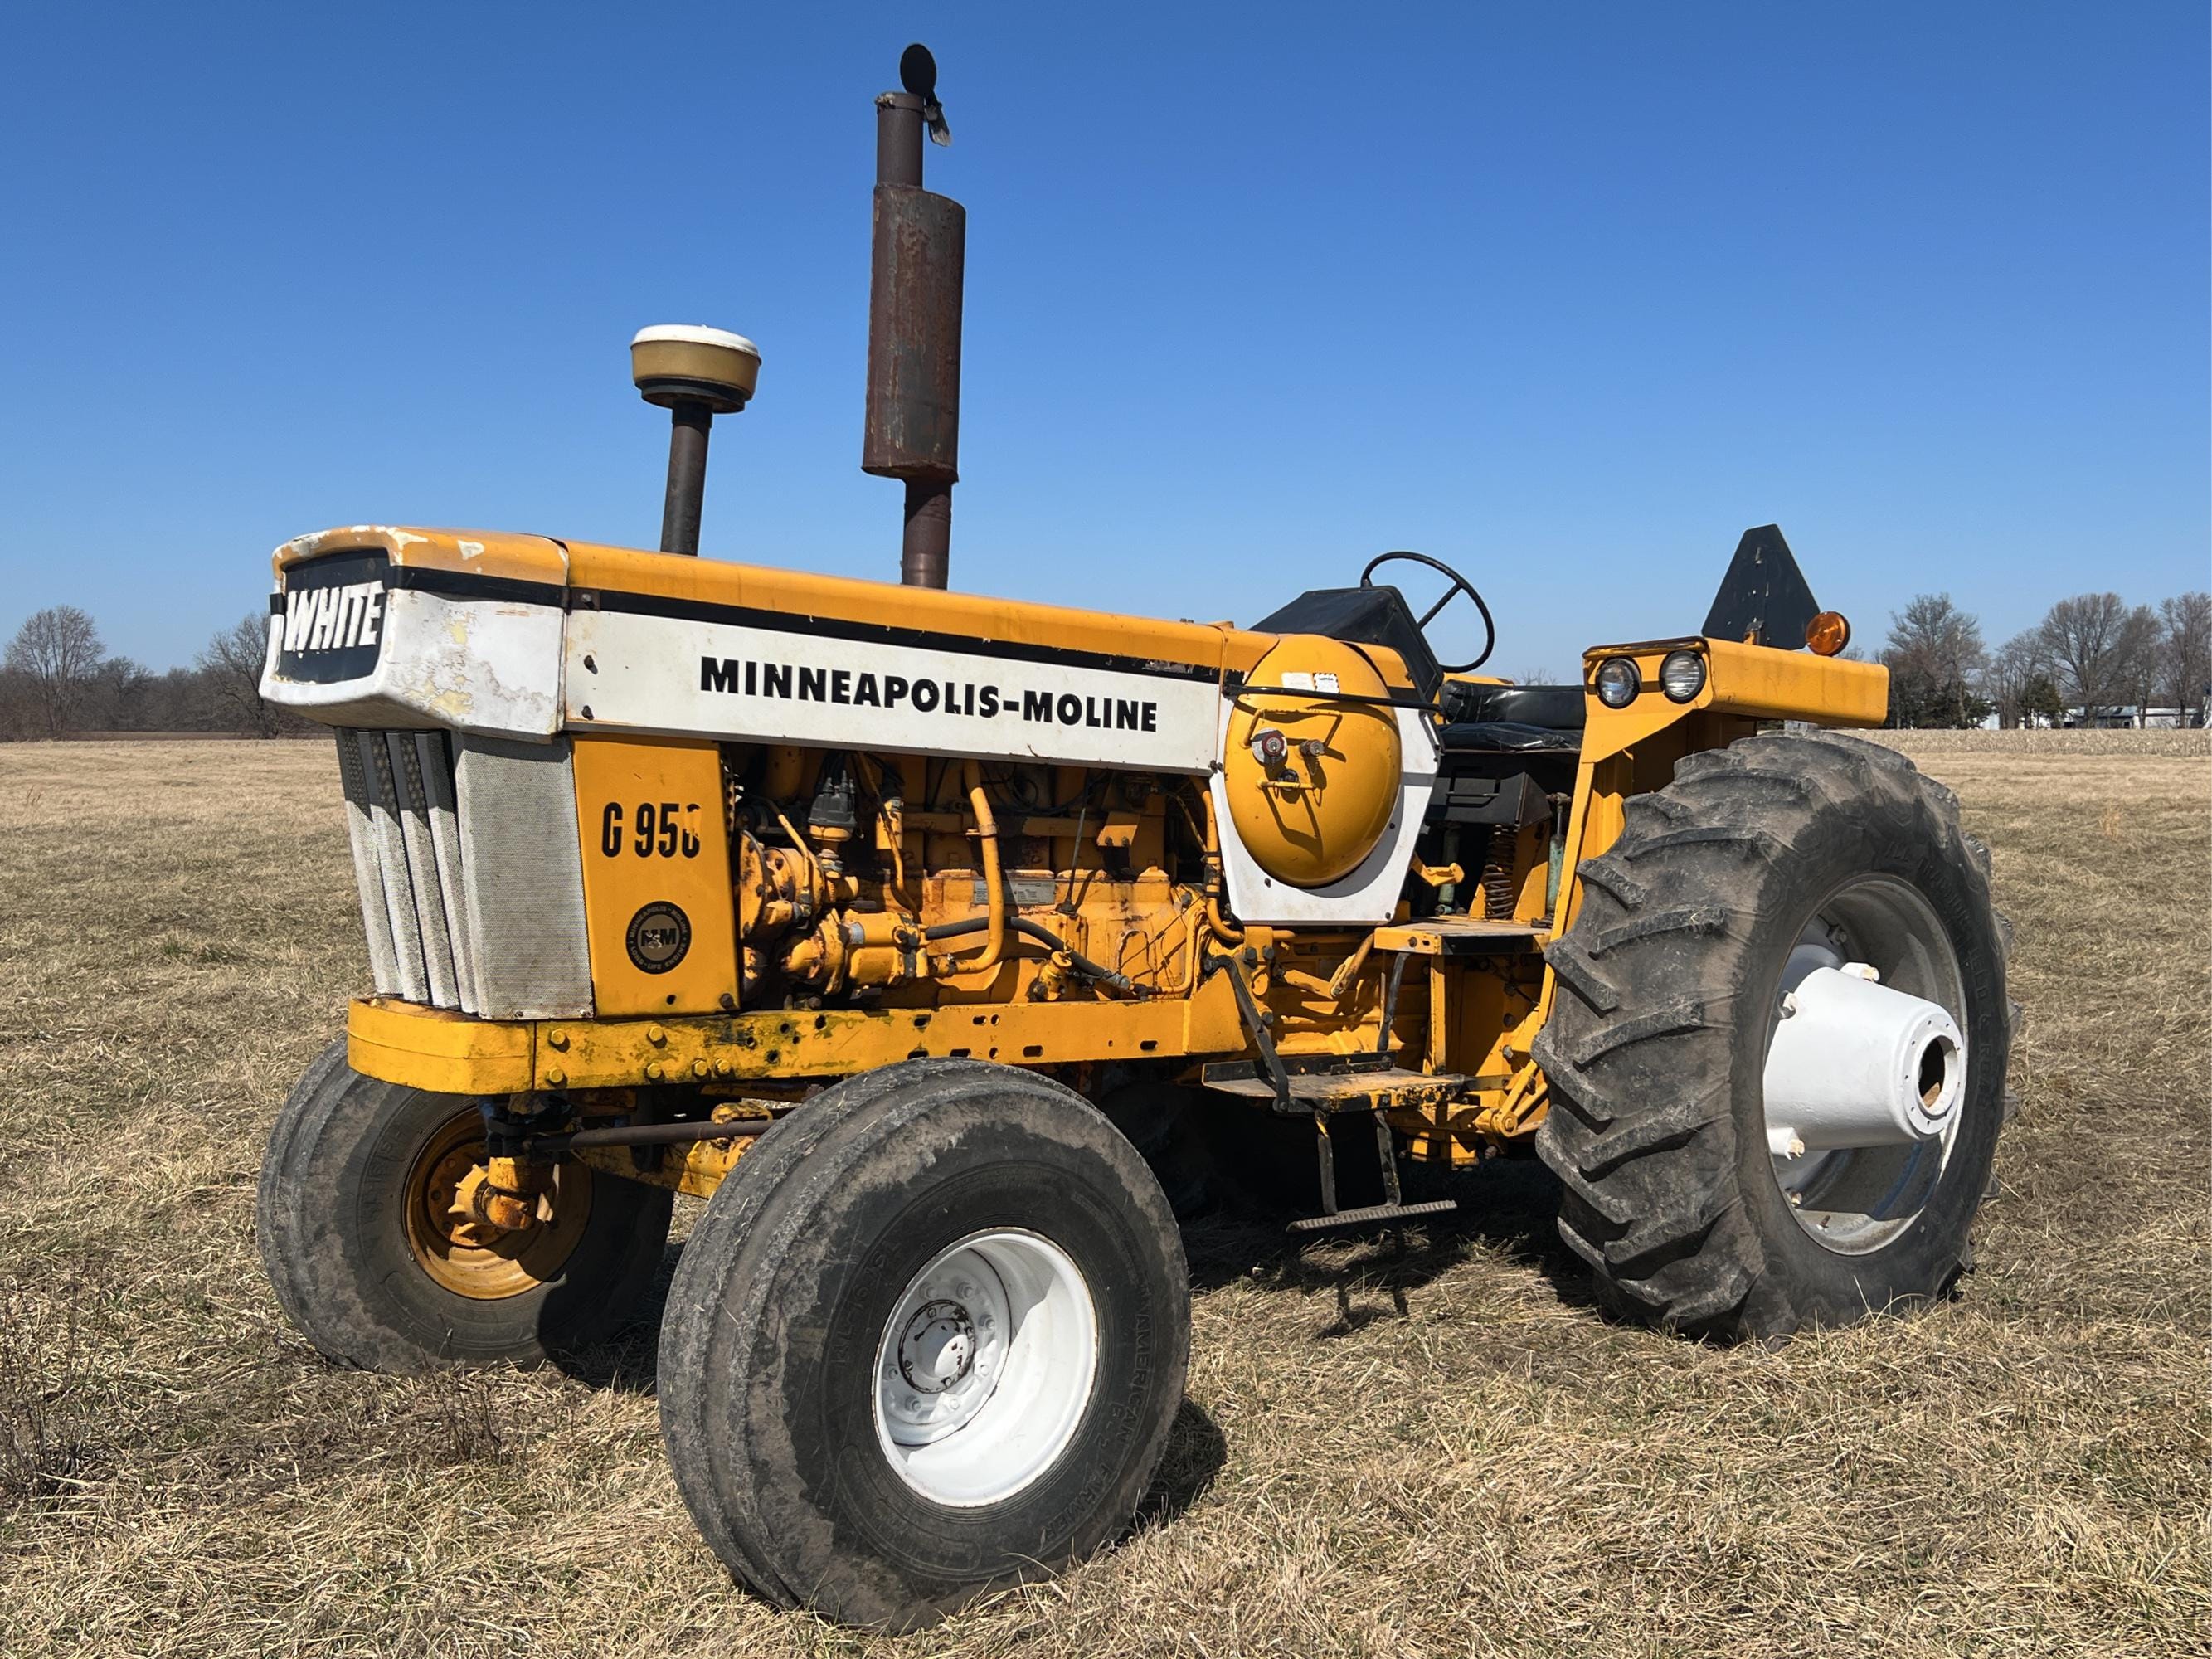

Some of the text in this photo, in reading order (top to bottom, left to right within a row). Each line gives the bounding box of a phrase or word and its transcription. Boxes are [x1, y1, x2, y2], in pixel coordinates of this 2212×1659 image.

[284, 581, 385, 652] WHITE
[700, 656, 1157, 732] MINNEAPOLIS-MOLINE
[601, 801, 624, 858] G
[1116, 1312, 1151, 1446] AMERICAN
